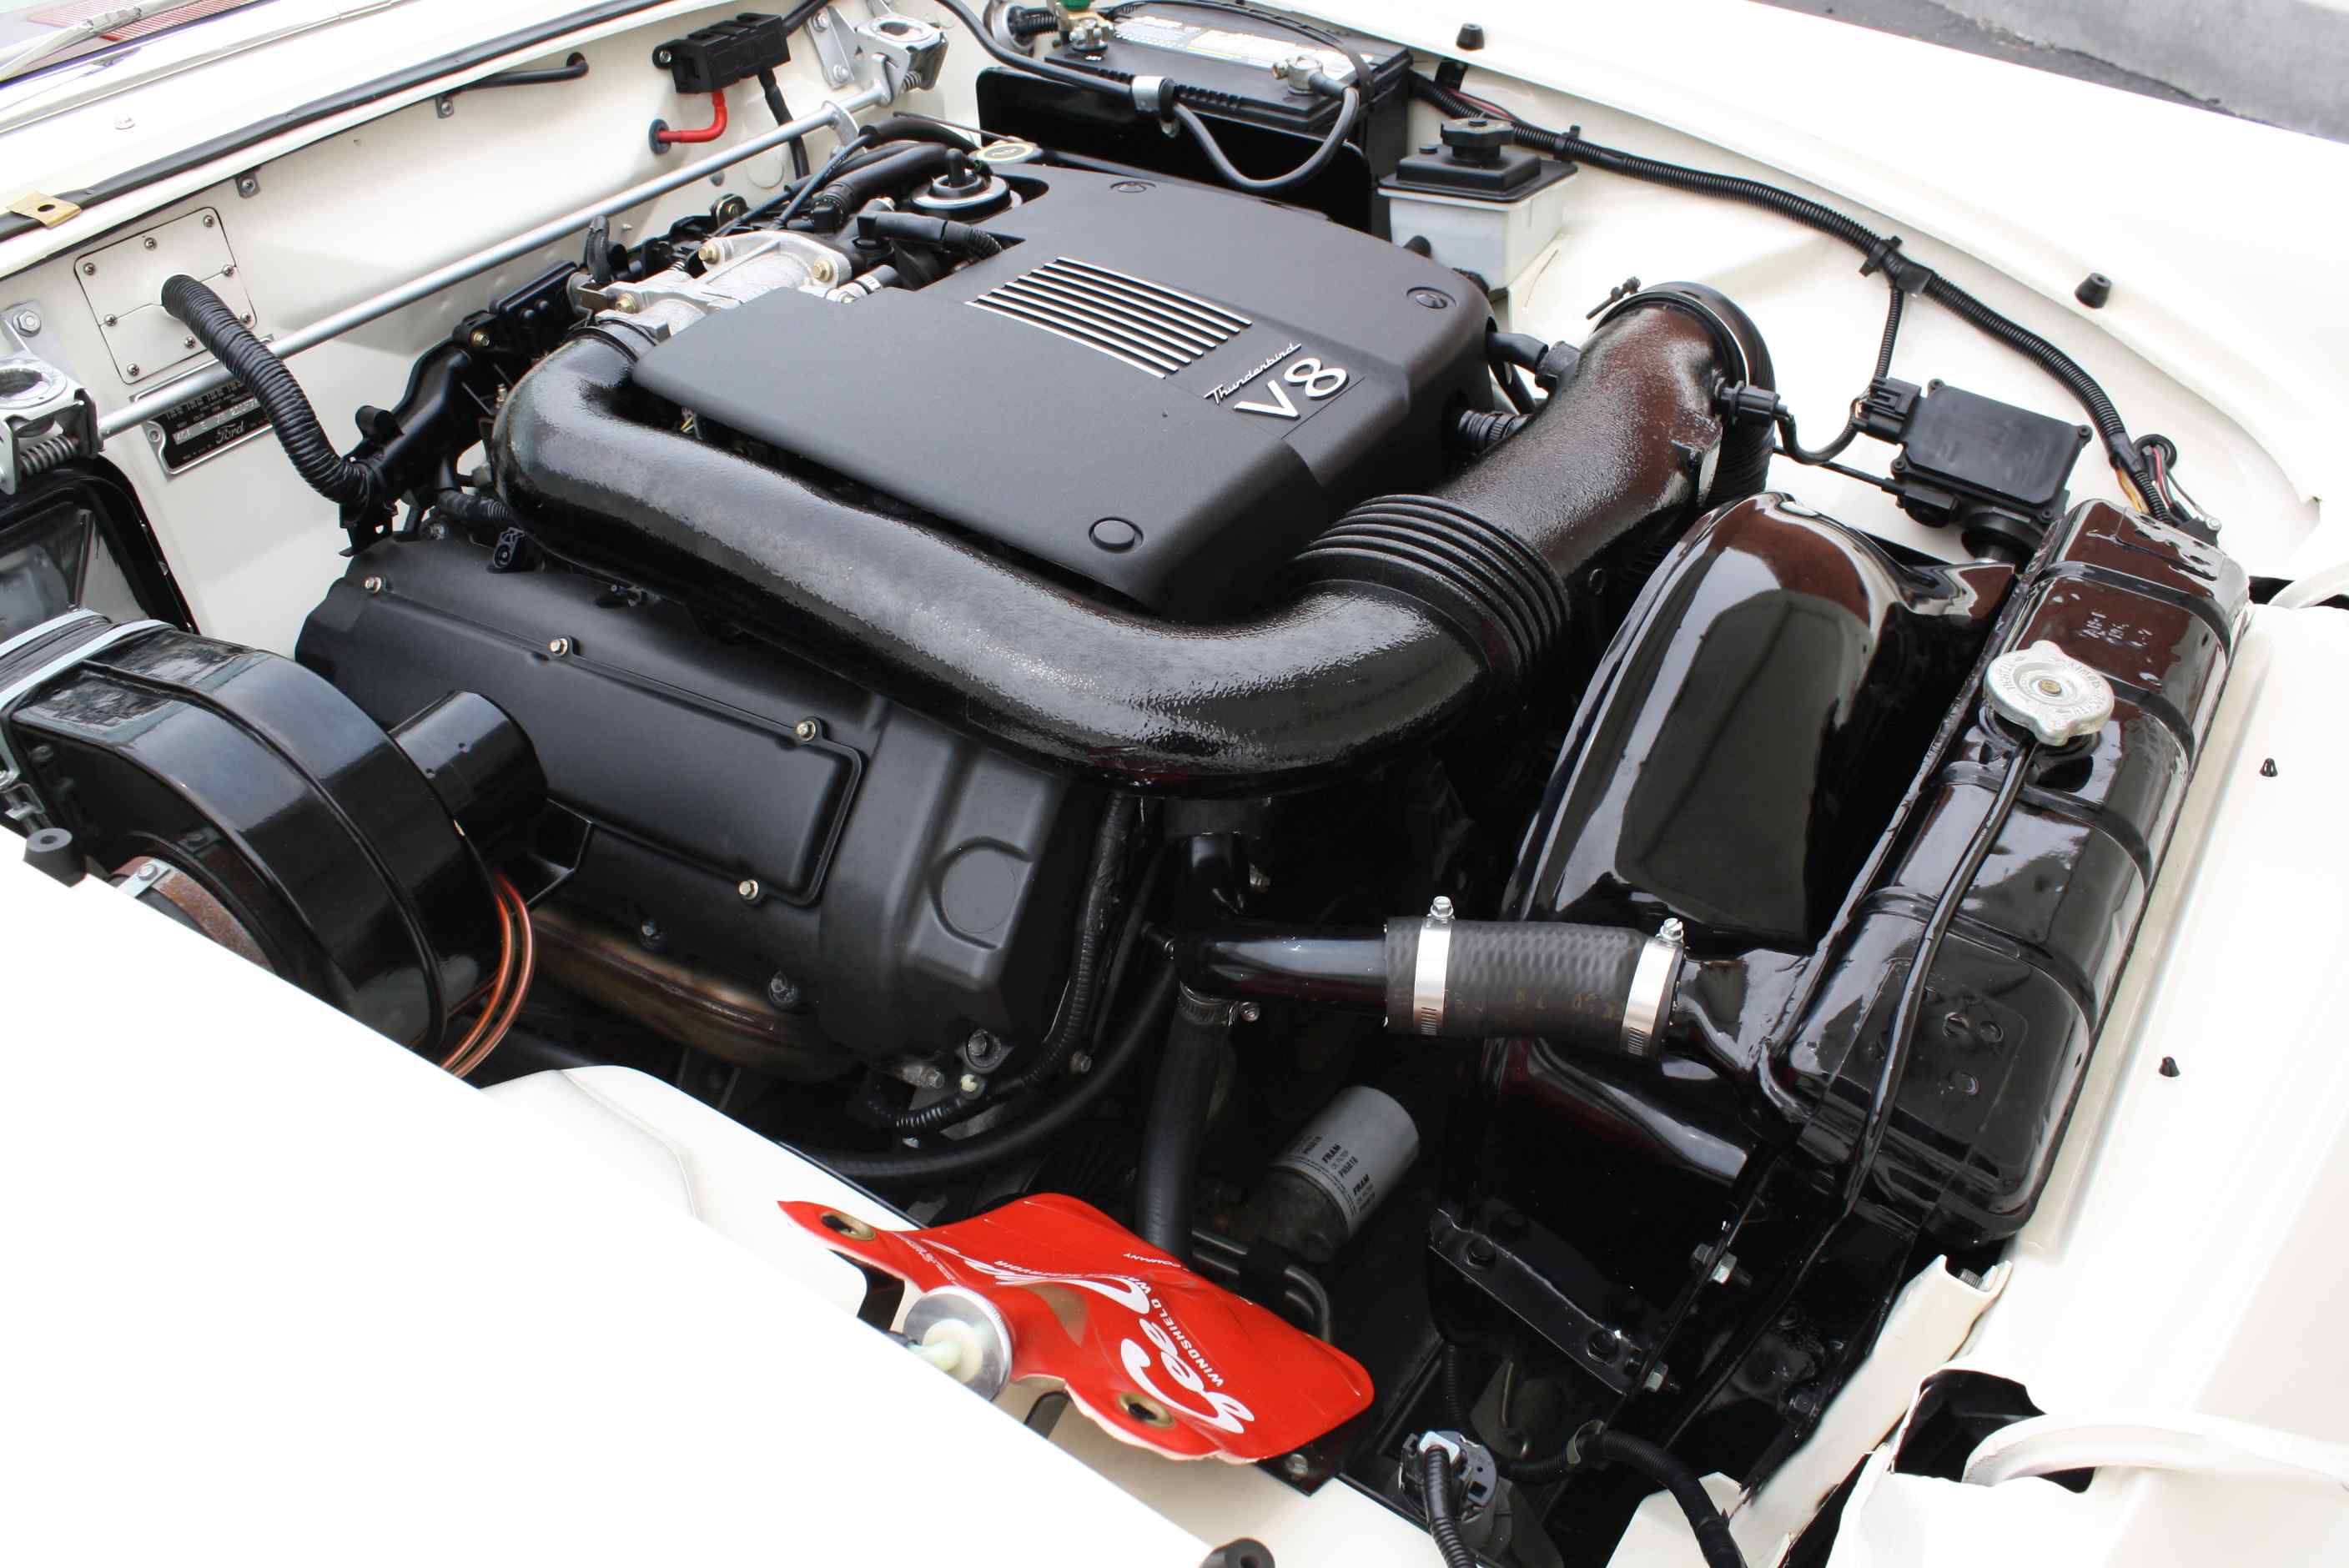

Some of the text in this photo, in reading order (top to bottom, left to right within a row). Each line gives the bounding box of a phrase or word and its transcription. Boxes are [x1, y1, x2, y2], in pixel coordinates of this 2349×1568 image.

[1204, 339, 1302, 405] Thunderbird
[1233, 358, 1349, 420] V8
[215, 420, 246, 444] Ford
[1321, 1143, 1342, 1164] FRAM
[1352, 1173, 1371, 1195] FRAM
[1150, 1298, 1224, 1388] WINDSHIELD
